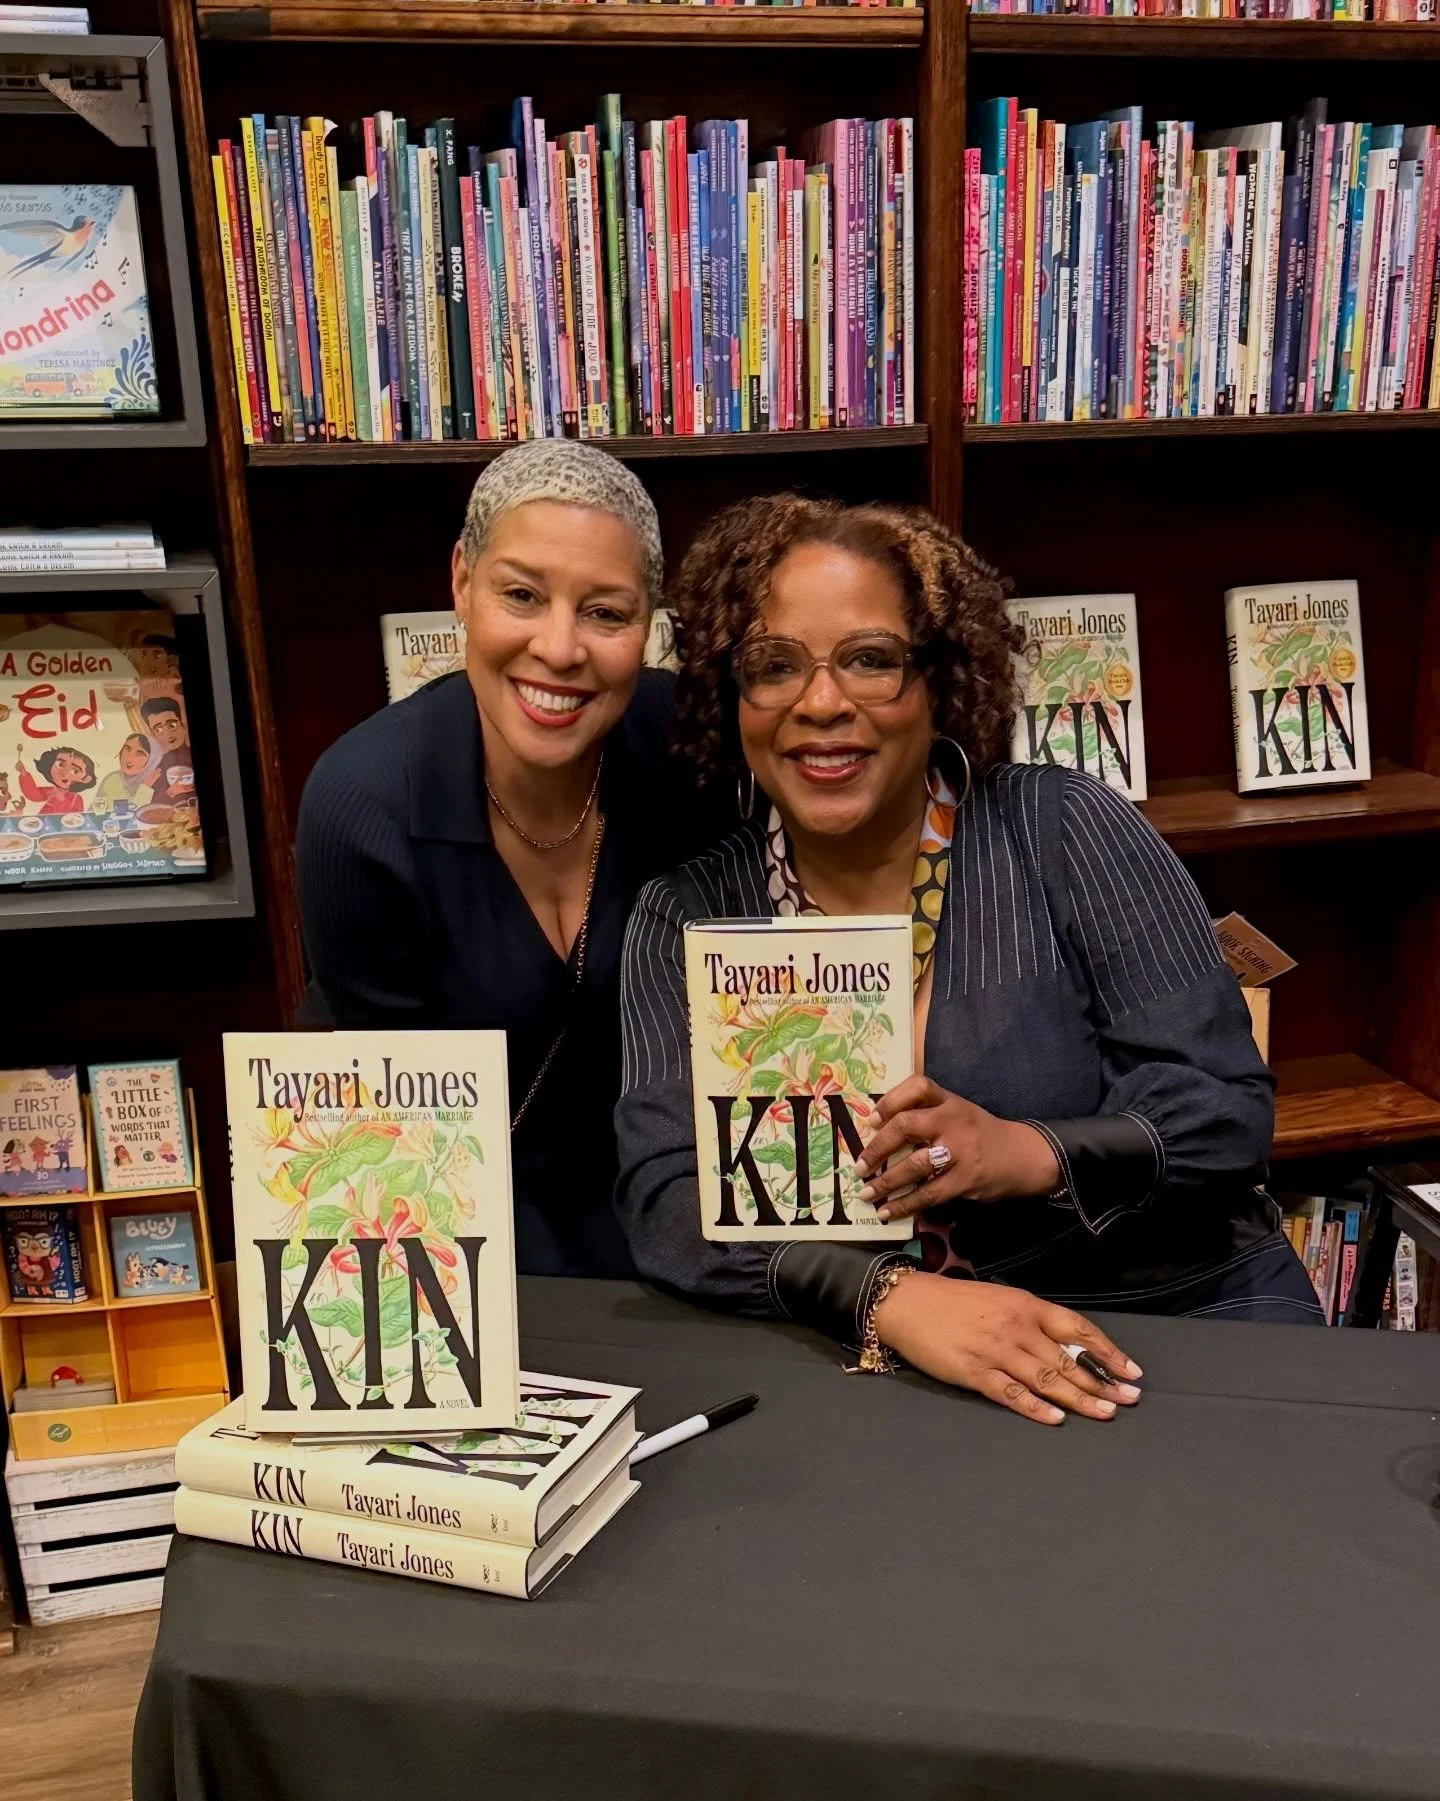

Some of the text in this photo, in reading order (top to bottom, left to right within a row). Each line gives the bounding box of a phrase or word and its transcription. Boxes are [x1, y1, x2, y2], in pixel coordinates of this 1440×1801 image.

[315, 136, 326, 160] Deedy
[446, 140, 455, 166] FANG
[1016, 134, 1025, 240] THE SECRETS OF MUSHROOMS
[1054, 166, 1064, 212] Washington,
[1244, 163, 1257, 266] WOMEN Mission
[253, 228, 264, 242] THE
[532, 224, 542, 256] MOON
[848, 234, 856, 256] HOME
[857, 230, 865, 252] HOME
[255, 246, 269, 294] MUSHROOM
[1183, 248, 1191, 272] BOOK
[280, 264, 292, 294] Pretty
[451, 247, 464, 303] BROKEN
[583, 264, 593, 286] YEAR
[261, 298, 271, 308] OF
[400, 228, 417, 362] THEY BUILT ME FOR FREEDOM
[585, 290, 594, 300] OF
[702, 264, 711, 336] BLUE IS MY HOME
[811, 270, 820, 324] My Friend May
[988, 288, 996, 316] LIGHT
[235, 258, 257, 372] HOW SWEET THE SOUND
[282, 296, 294, 324] Sound
[376, 296, 386, 326] ALFIE
[426, 286, 438, 342] My Olive Tree
[585, 304, 595, 330] PRIDE
[786, 290, 794, 332] TRIANGLES
[712, 314, 721, 338] Sand
[721, 314, 730, 338] Sand
[760, 328, 767, 338] OR
[587, 342, 597, 362] JOY
[1018, 607, 1127, 640] Tayari Jones
[1245, 594, 1349, 627] Tayari Jones
[396, 626, 460, 662] Tayari
[1226, 635, 1238, 666] KIN
[1, 651, 113, 677] A Golden
[12, 684, 99, 740] Eid
[1249, 682, 1356, 779] KIN
[1021, 700, 1133, 790] KIN
[1237, 947, 1274, 975] SIGNING
[704, 953, 891, 1007] Tayari Jones
[811, 996, 820, 1004] AN
[820, 996, 853, 1005] AMERICAN
[111, 1088, 162, 1104] LITTLE
[126, 1078, 143, 1087] THE
[249, 1057, 478, 1123] Tayari Jones
[14, 1096, 60, 1114] FIRST
[117, 1105, 162, 1121] BOX OF
[304, 1112, 345, 1123] Bestselling
[371, 1111, 380, 1121] of
[380, 1111, 392, 1121] AN
[393, 1111, 433, 1121] AMERICAN
[434, 1110, 474, 1121] MARRIAGE
[0, 1113, 76, 1132] FEELINGS
[111, 1120, 171, 1134] WORDS THAT
[124, 1131, 162, 1143] MATTER
[708, 1094, 888, 1227] KIN
[36, 1170, 49, 1181] 30
[253, 1237, 488, 1412] KIN
[440, 1399, 470, 1409] A NOVEL
[253, 1462, 462, 1529] KIN Tayari Jones
[251, 1509, 455, 1579] KIN Tayari Jones
